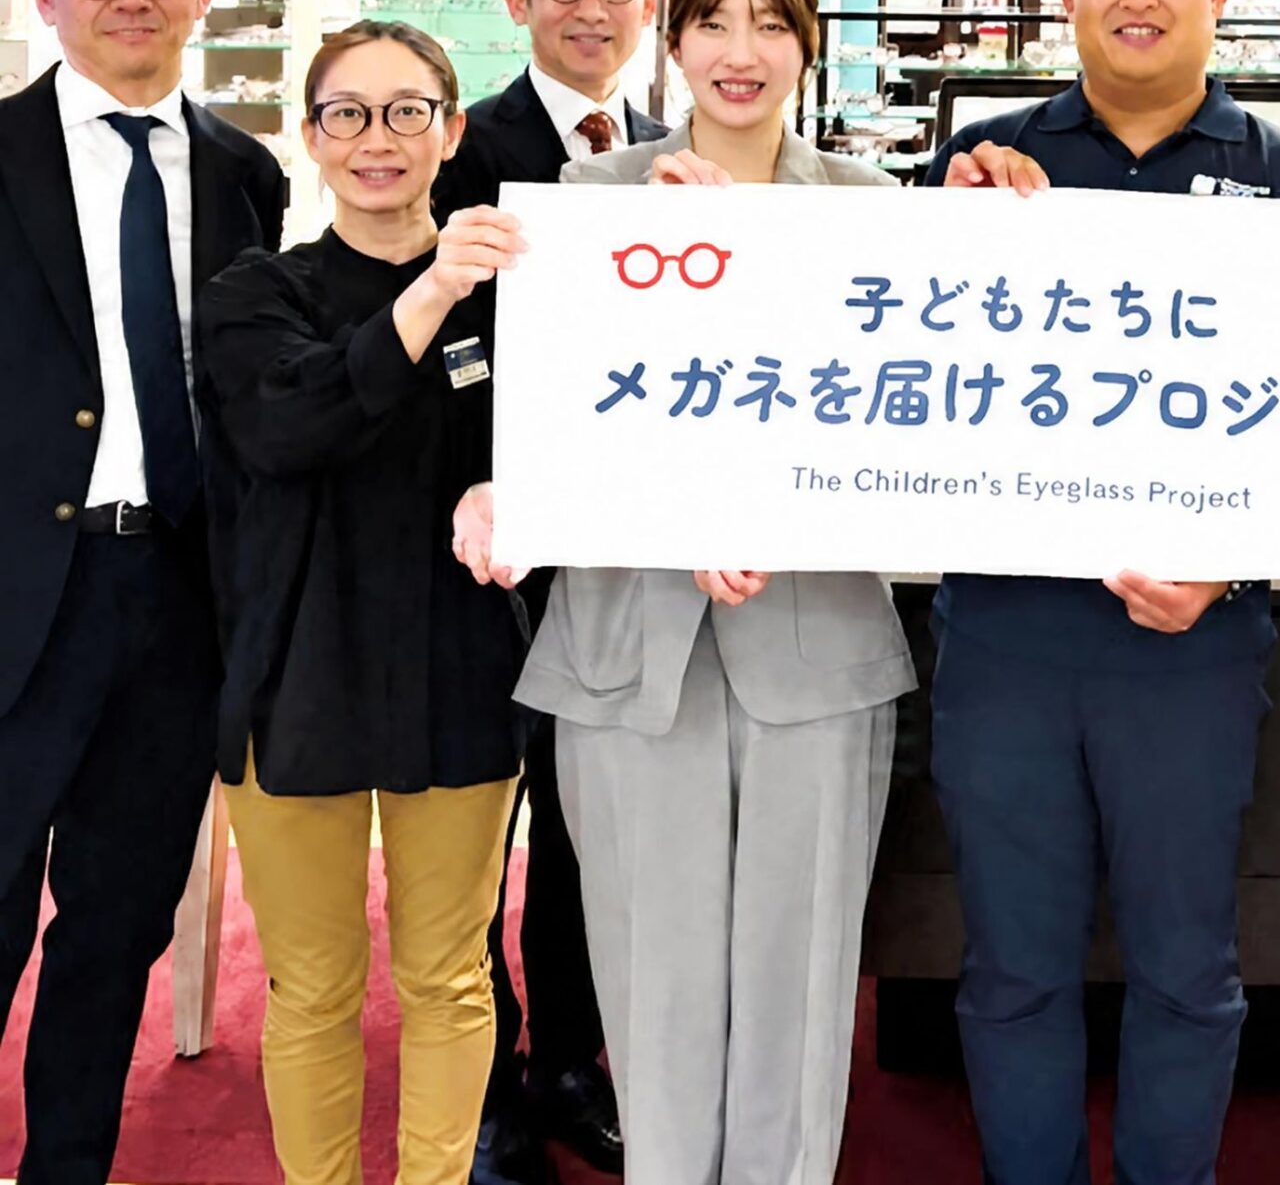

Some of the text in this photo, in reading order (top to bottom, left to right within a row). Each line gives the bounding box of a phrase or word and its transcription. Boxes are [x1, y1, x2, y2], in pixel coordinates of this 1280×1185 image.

[844, 275, 1219, 340] 子どもたちに
[791, 466, 842, 492] The
[1017, 472, 1135, 503] Eyeglass
[1148, 481, 1251, 514] Project
